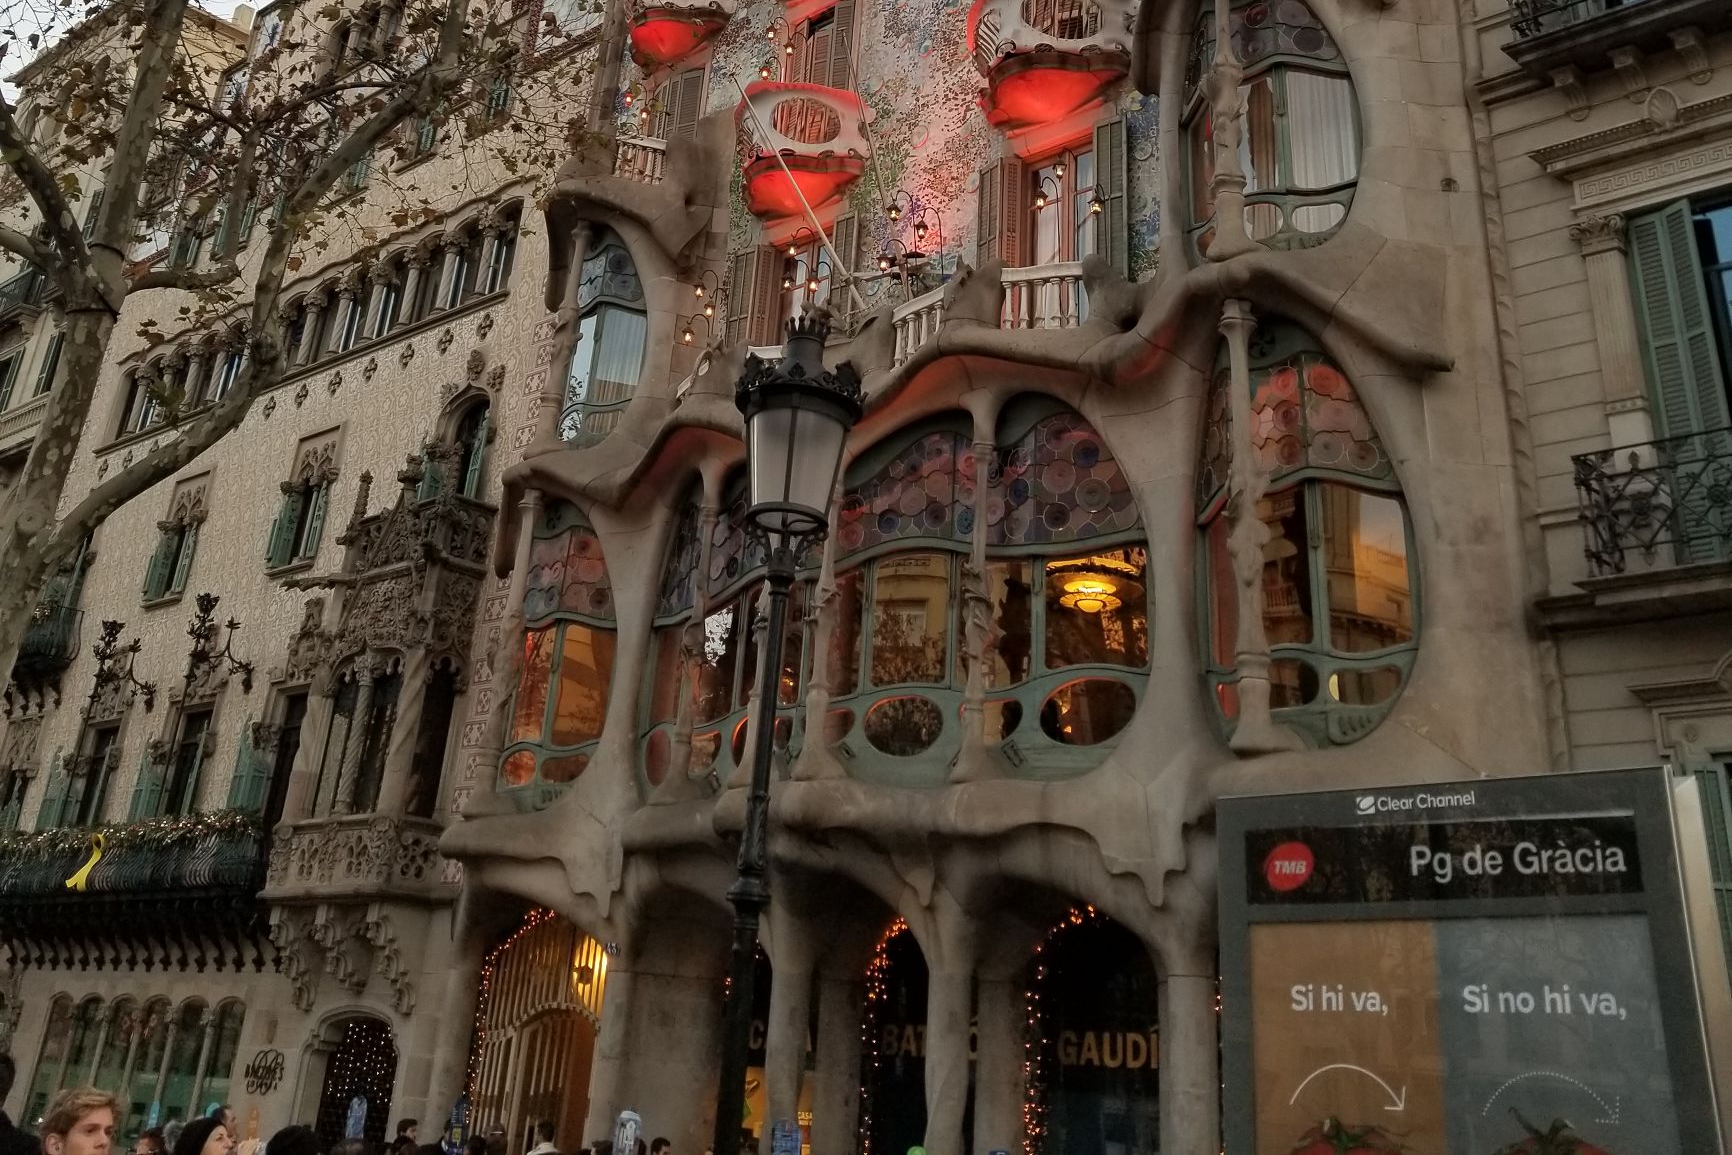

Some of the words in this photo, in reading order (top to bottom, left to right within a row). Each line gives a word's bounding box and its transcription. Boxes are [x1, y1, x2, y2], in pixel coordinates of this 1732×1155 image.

[1377, 793, 1414, 811] Clear
[1416, 791, 1476, 809] Channel
[1274, 860, 1306, 874] TMB
[1410, 846, 1453, 883] Pg
[1462, 845, 1503, 876] de
[1513, 840, 1627, 874] Gràcia
[1291, 984, 1314, 1011] Si
[1321, 984, 1344, 1012] hi
[1351, 991, 1389, 1016] va,
[1463, 984, 1490, 1013] Si
[1499, 990, 1535, 1013] no
[1544, 983, 1571, 1014] hi
[1579, 991, 1627, 1020] va,
